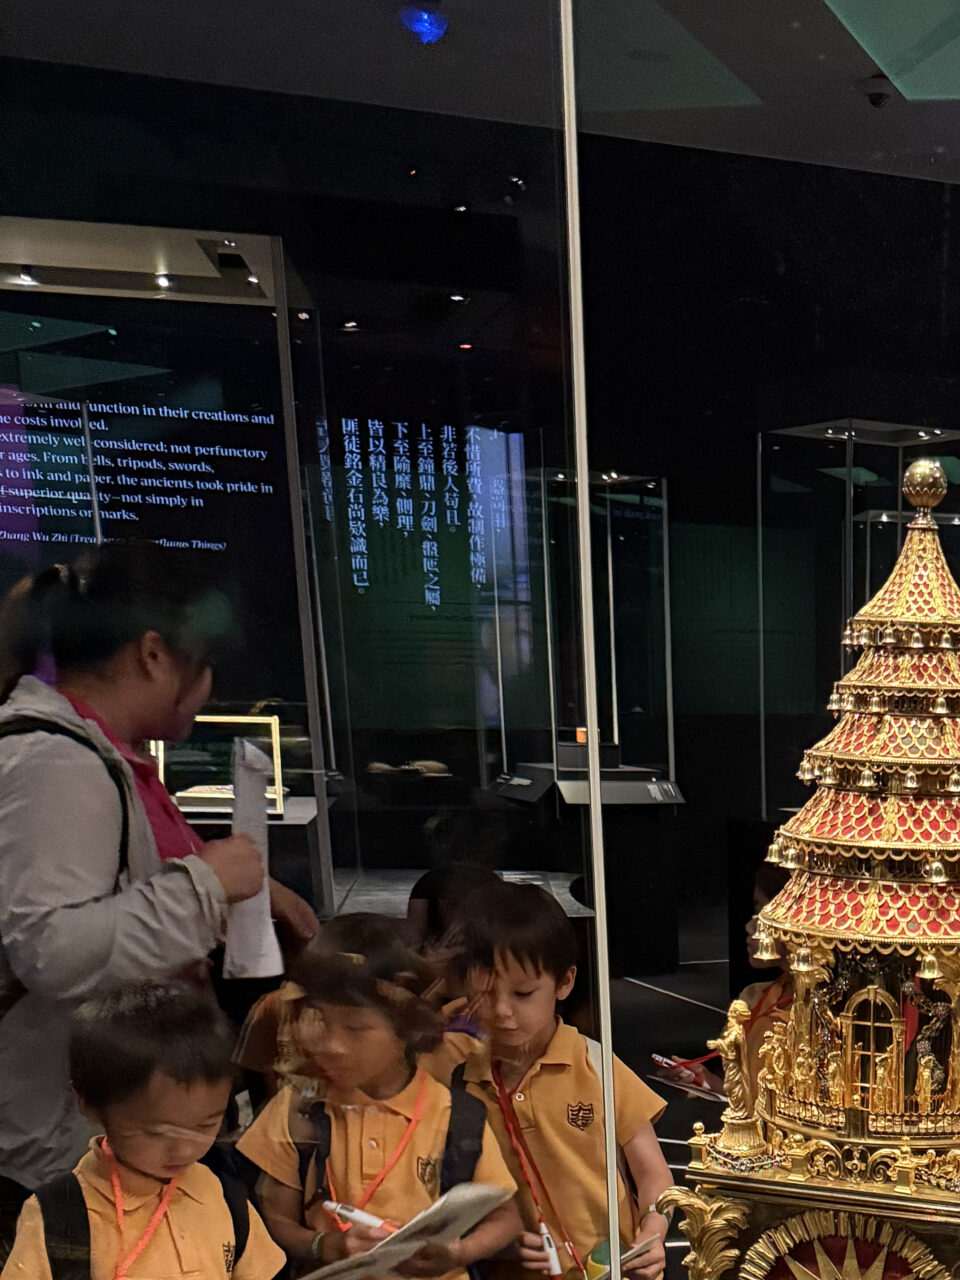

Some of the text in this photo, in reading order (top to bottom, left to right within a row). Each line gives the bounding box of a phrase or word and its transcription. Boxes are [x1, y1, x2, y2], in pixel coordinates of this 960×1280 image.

[14, 413, 48, 427] costs
[50, 416, 109, 431] involed.
[86, 402, 140, 417] unction
[142, 404, 156, 417] in
[159, 405, 190, 420] their
[192, 408, 250, 424] creations
[251, 413, 275, 425] and
[63, 435, 168, 454] wel-considered;
[170, 442, 192, 455] not
[194, 445, 268, 461] perfunctory
[8, 452, 41, 464] ages.
[43, 451, 78, 465] From
[168, 460, 215, 475] swords,
[5, 468, 20, 480] to
[22, 468, 44, 481] ink
[47, 471, 72, 483] and
[117, 473, 139, 486] the
[140, 476, 194, 491] ancients
[196, 479, 224, 491] took
[226, 482, 259, 495] pride
[261, 483, 274, 495] in
[8, 486, 64, 500] superior
[146, 493, 189, 508] simply
[191, 496, 205, 508] in
[80, 509, 93, 518] or
[33, 532, 49, 542] Wu
